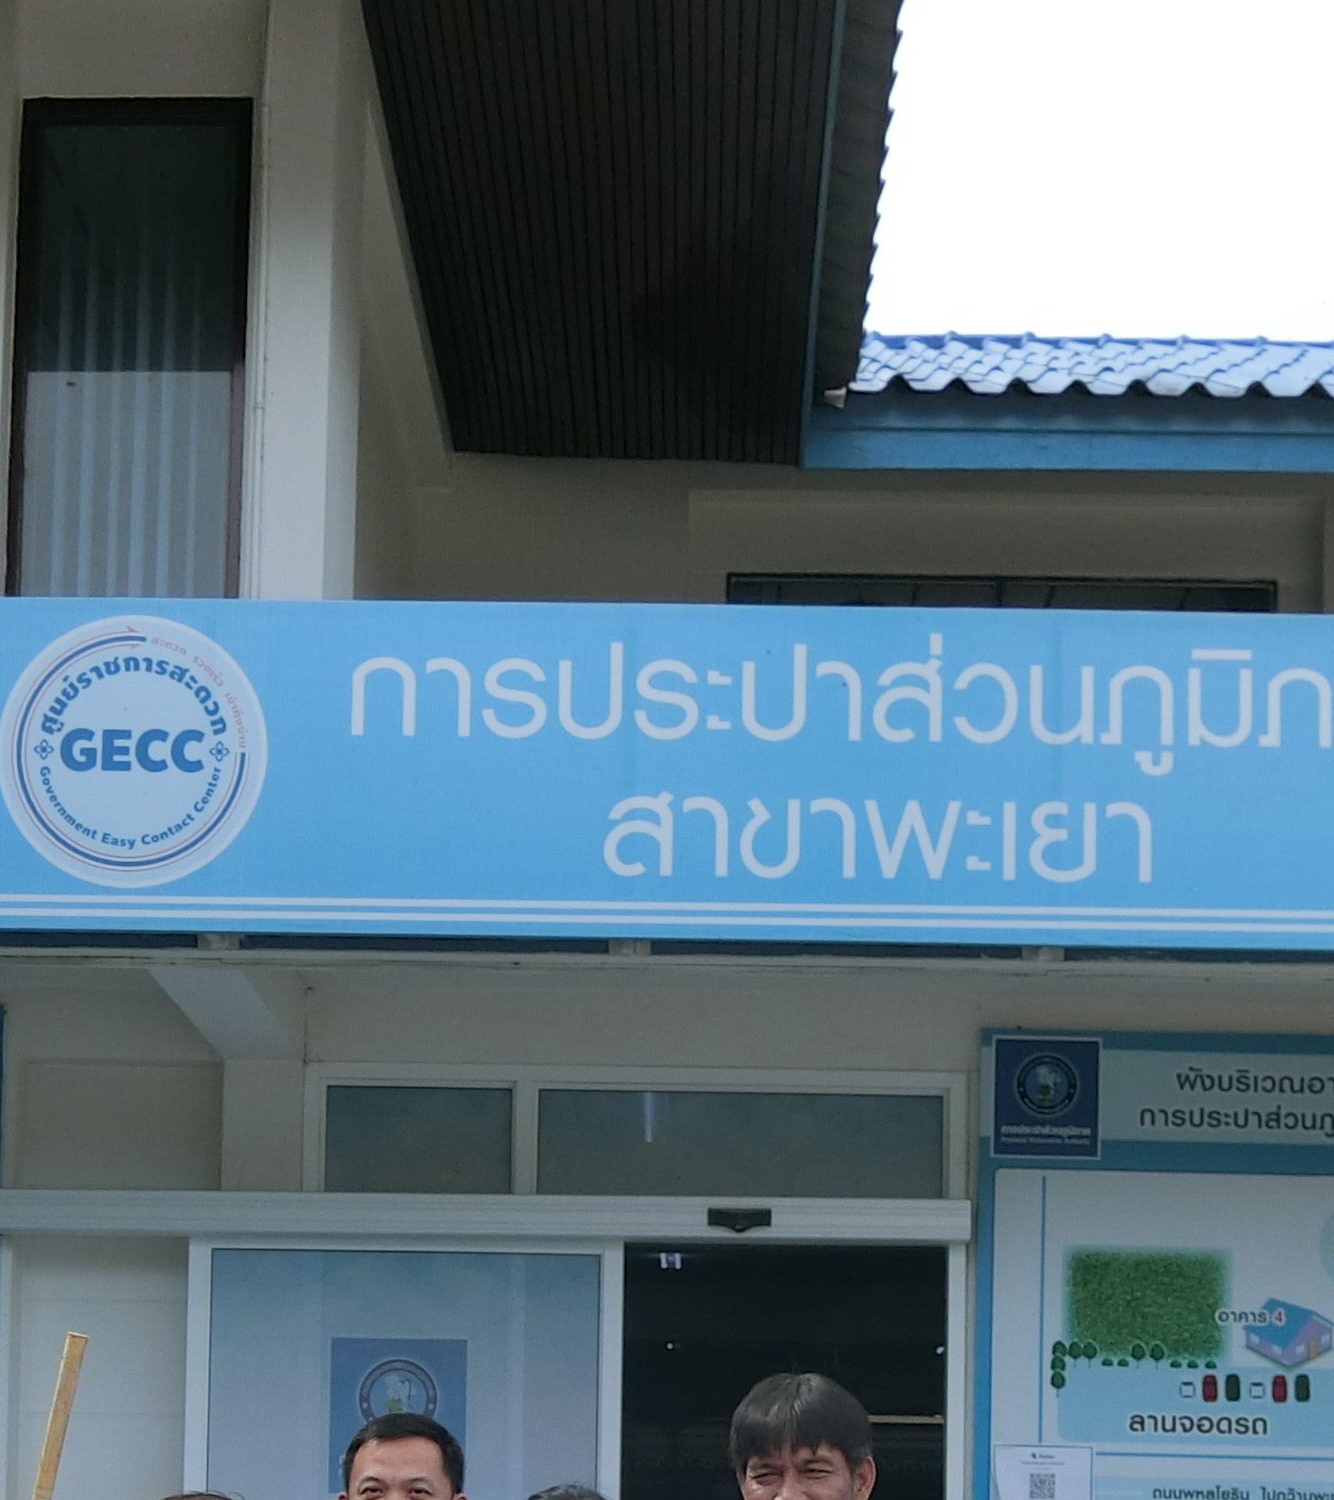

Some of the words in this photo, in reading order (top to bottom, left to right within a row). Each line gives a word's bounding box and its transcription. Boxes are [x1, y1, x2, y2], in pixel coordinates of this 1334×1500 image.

[41, 656, 227, 735] ศูนย์ราชการสะดวก
[60, 728, 205, 774] GECC
[40, 766, 98, 840] Government
[101, 833, 137, 850] Easy
[141, 813, 195, 846] Contact
[194, 767, 221, 813] Center
[603, 792, 1154, 884] สาขาพะเยา
[1217, 1310, 1267, 1324] อาคาร
[1273, 1310, 1283, 1324] 4
[1128, 1412, 1269, 1437] ลานจอดรถ
